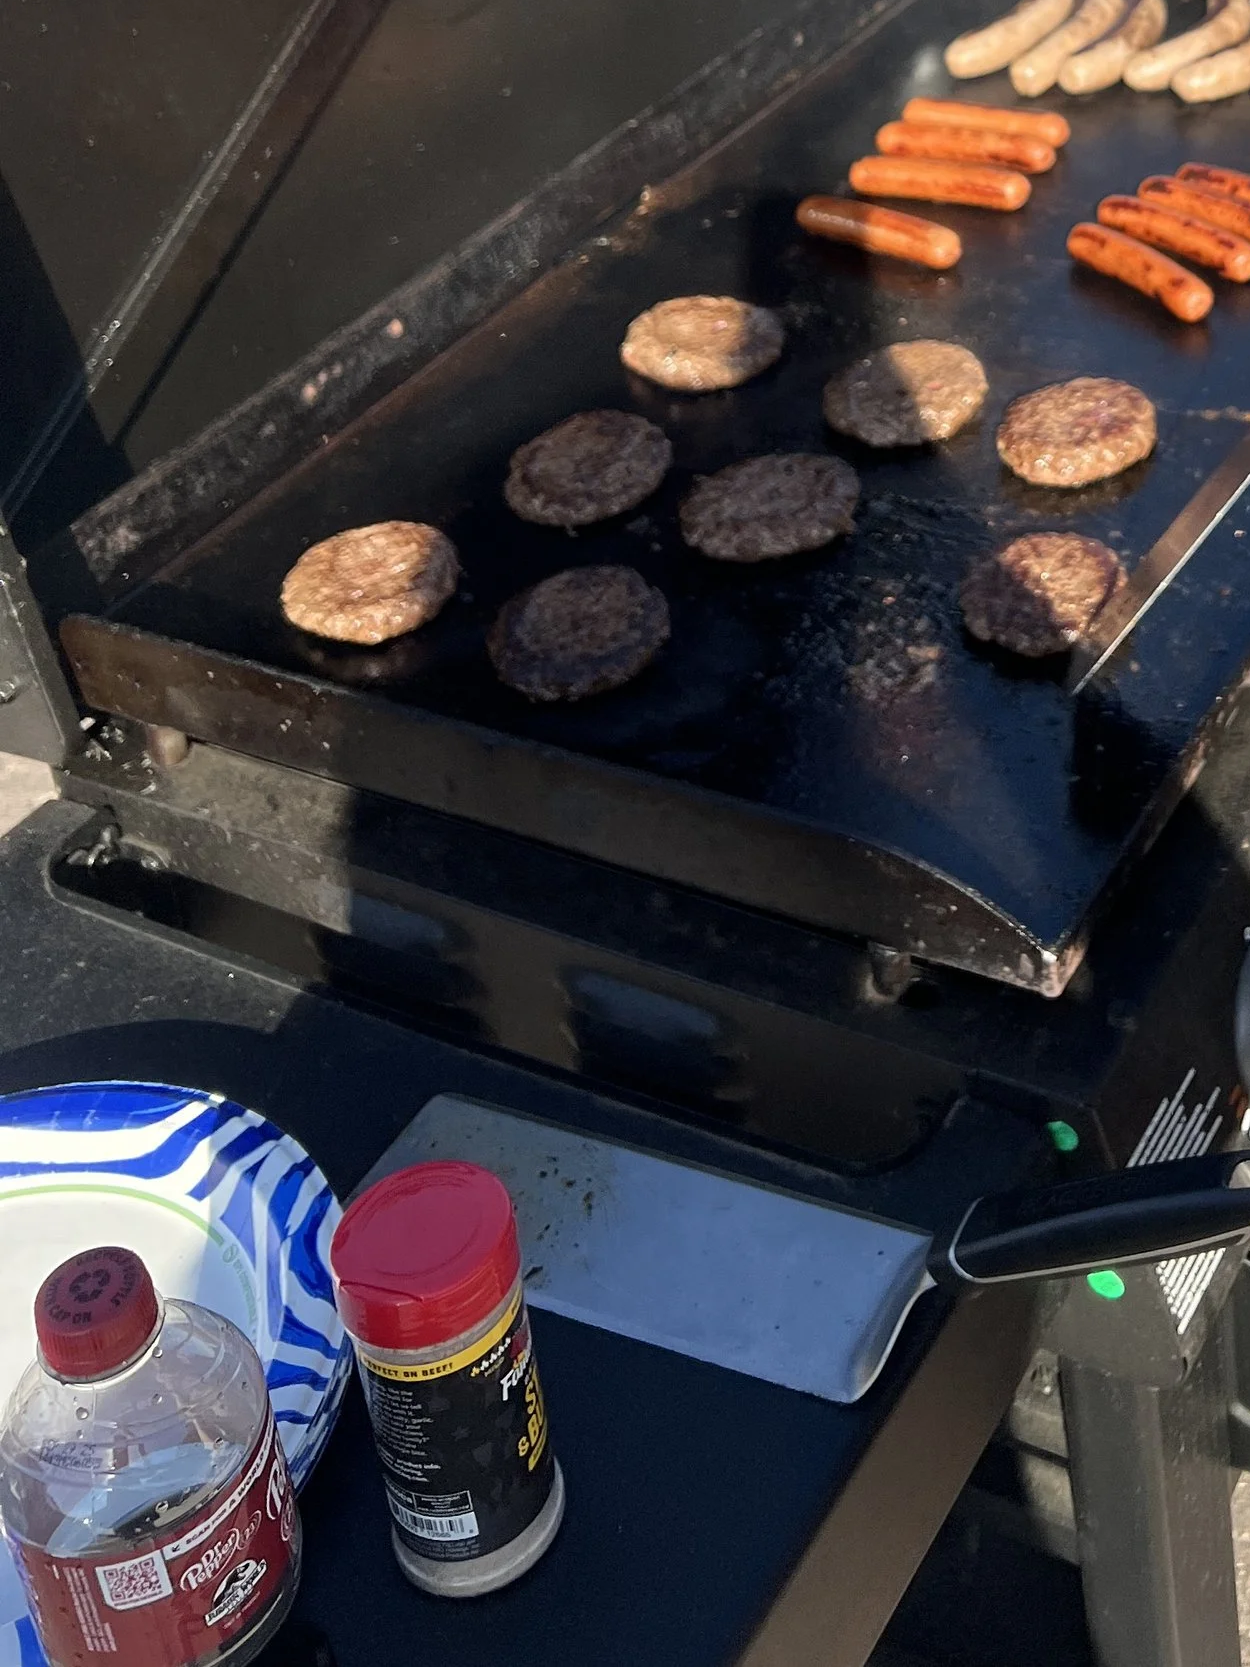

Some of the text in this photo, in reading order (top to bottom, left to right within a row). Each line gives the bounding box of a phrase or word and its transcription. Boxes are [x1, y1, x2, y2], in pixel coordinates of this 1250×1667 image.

[49, 1305, 92, 1324] CAP ON
[422, 1362, 453, 1377] BEEF!
[185, 1524, 211, 1545] SCAN
[180, 1528, 240, 1591] Pepper
[201, 1541, 222, 1566] Dr
